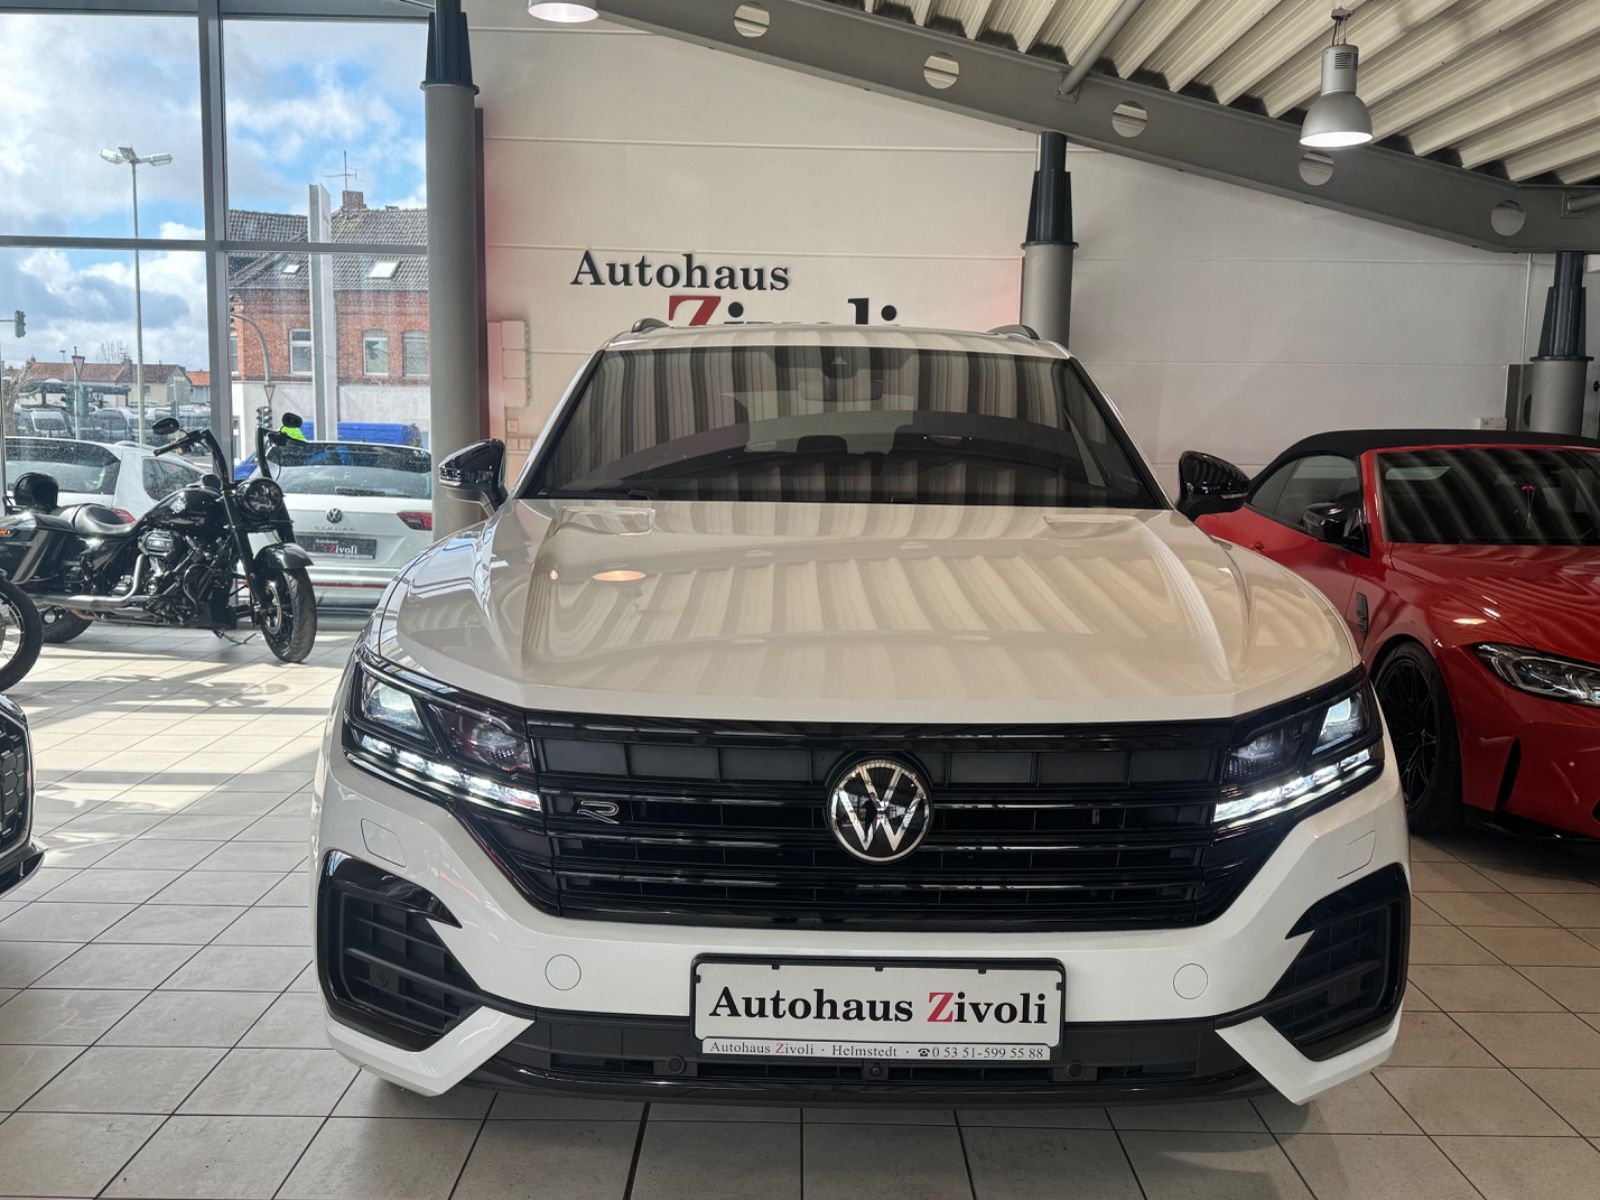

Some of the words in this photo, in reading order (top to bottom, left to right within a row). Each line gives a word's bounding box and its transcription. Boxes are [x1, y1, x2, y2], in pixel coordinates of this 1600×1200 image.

[570, 250, 790, 291] Autohaus
[831, 760, 931, 862] VW
[708, 986, 914, 1022] Autohaus
[927, 991, 1048, 1024] Zivoli
[709, 1041, 771, 1054] Autohaus
[775, 1043, 814, 1055] Zivoli
[832, 1044, 897, 1057] Helmstedt
[1010, 1048, 1025, 1059] 55
[1029, 1048, 1043, 1059] 88
